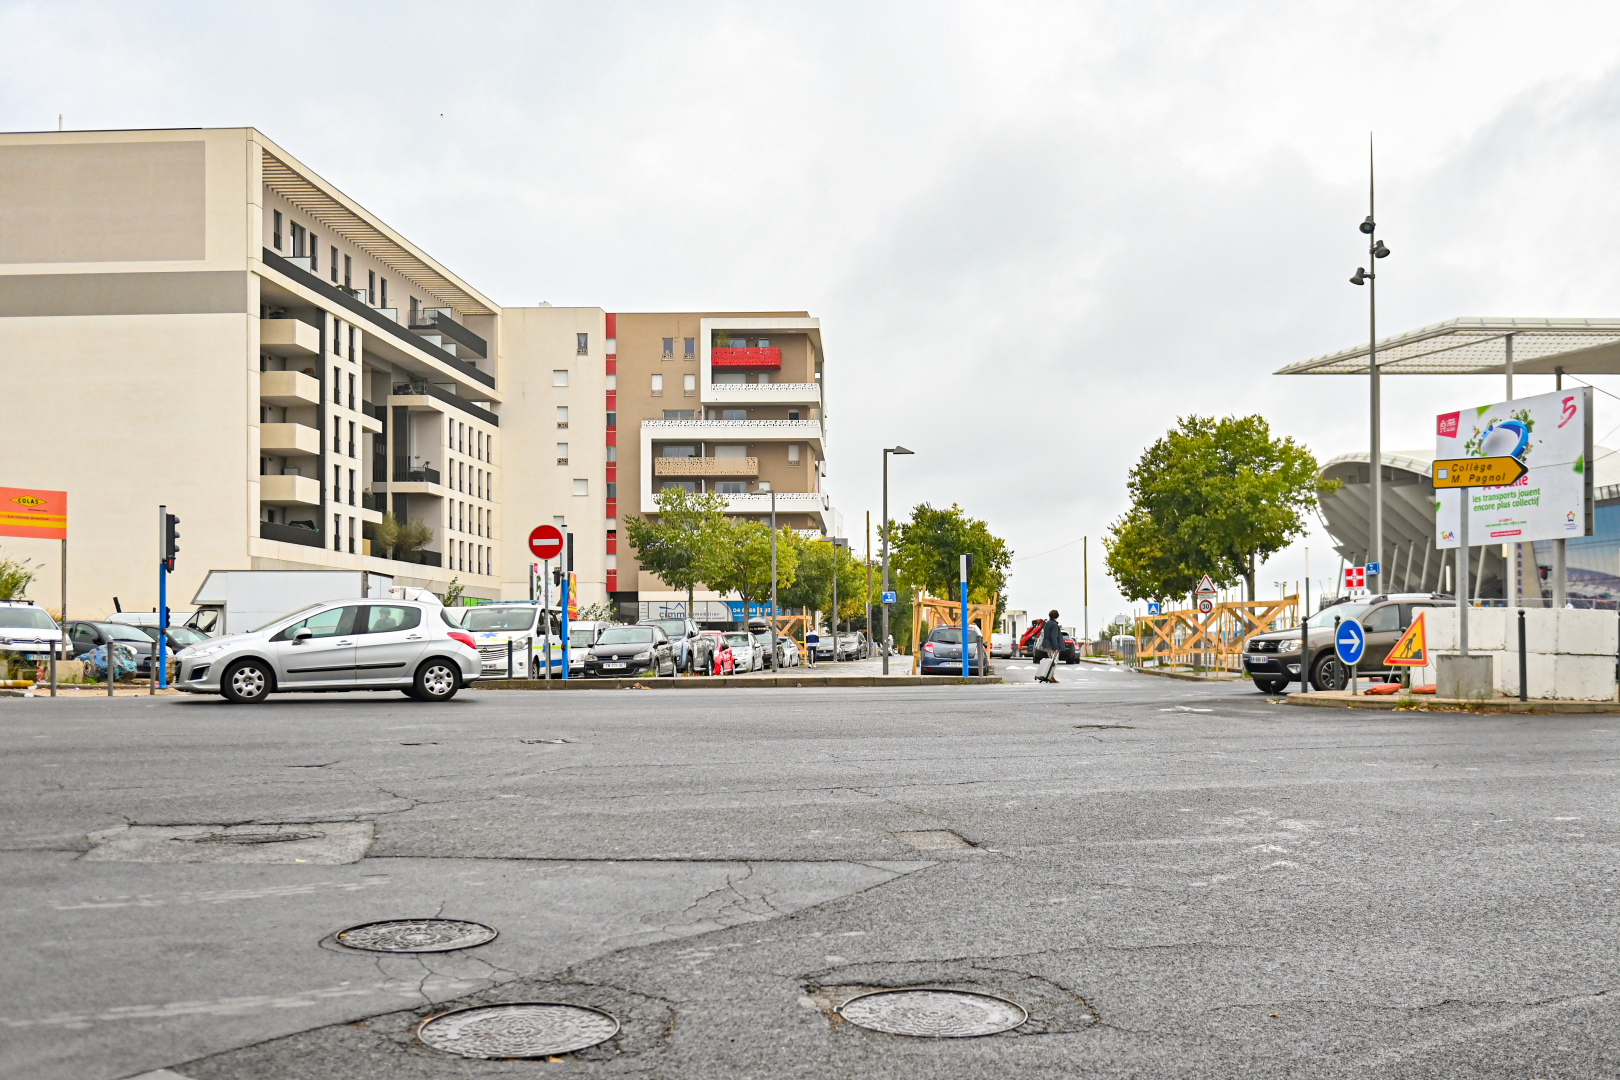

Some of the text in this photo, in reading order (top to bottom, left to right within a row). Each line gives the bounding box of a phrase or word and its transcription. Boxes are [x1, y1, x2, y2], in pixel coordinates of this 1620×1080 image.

[1557, 396, 1578, 429] 5
[1451, 463, 1493, 473] Collège
[1451, 475, 1463, 484] M.
[1468, 473, 1506, 484] Pagnol
[1472, 495, 1482, 503] les
[1483, 491, 1517, 502] transports
[1518, 488, 1541, 499] jouent
[1474, 496, 1540, 512] encore plus collectif
